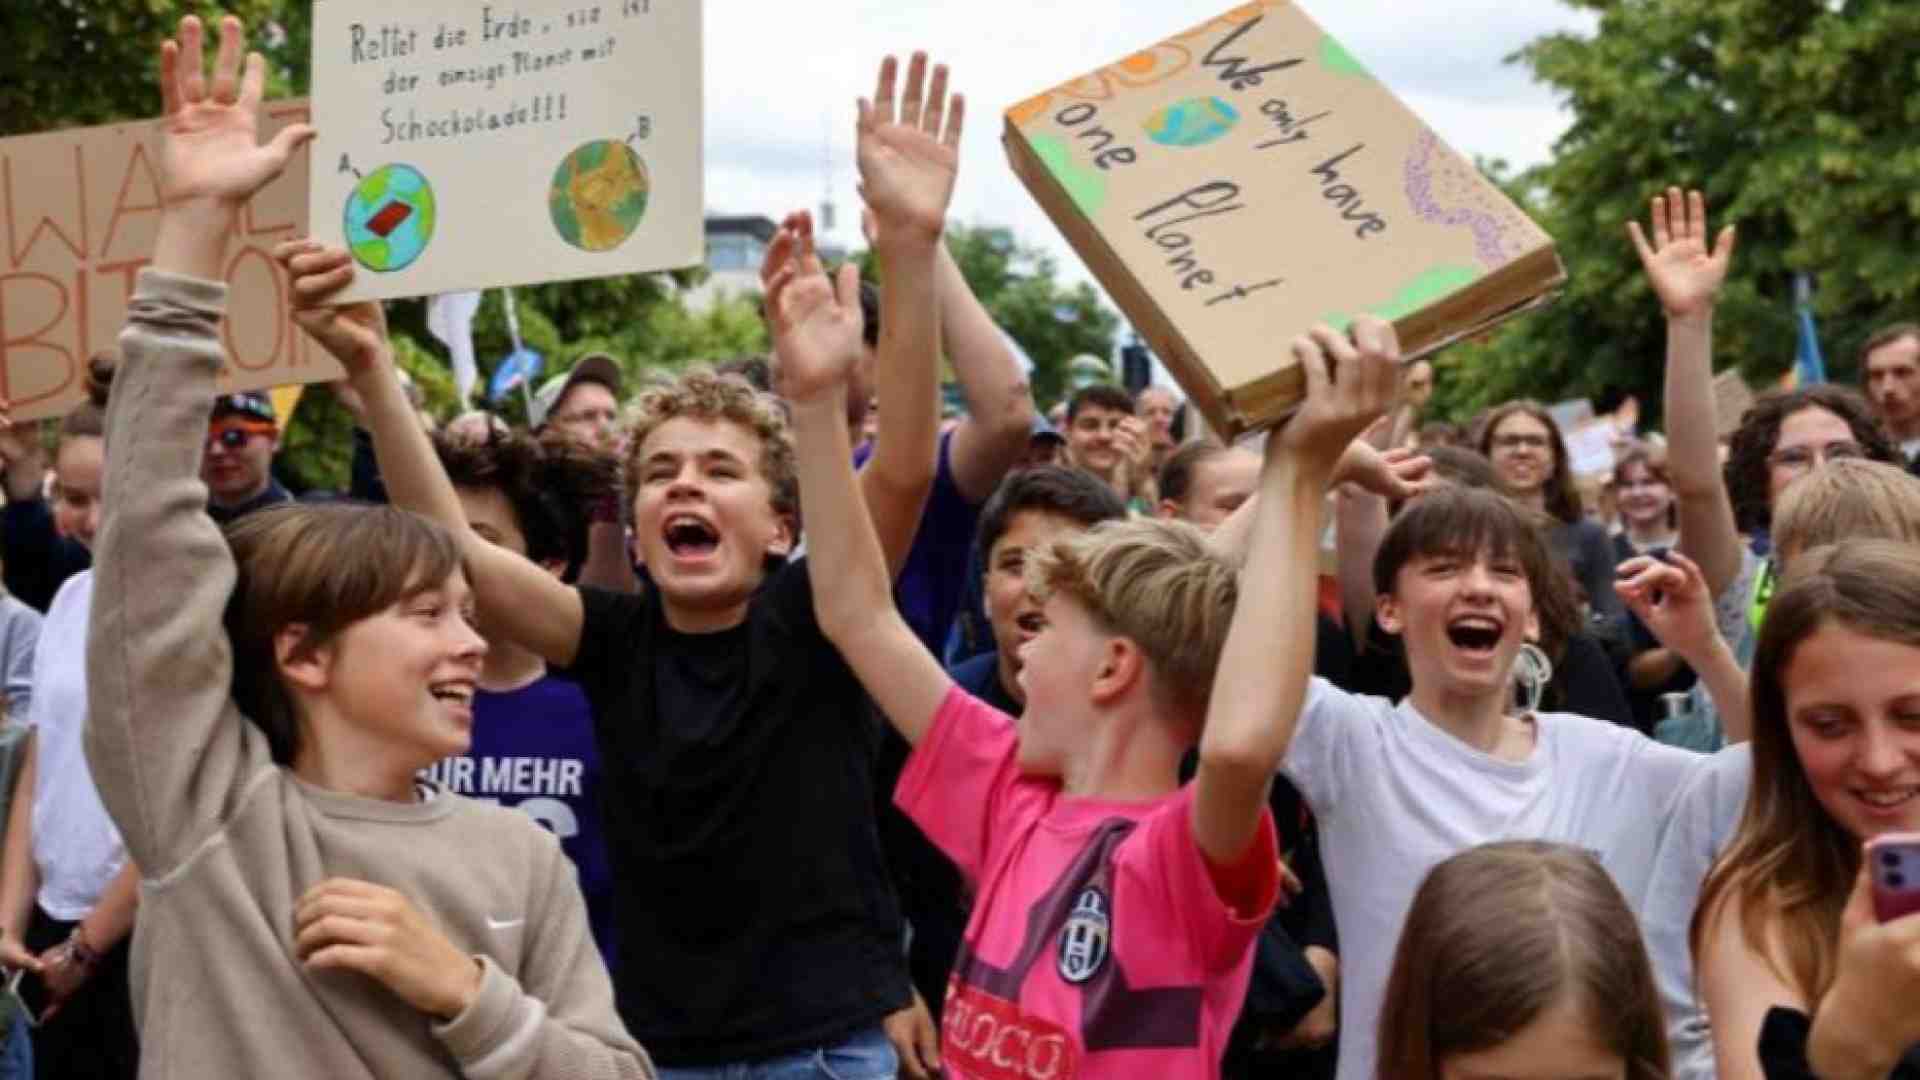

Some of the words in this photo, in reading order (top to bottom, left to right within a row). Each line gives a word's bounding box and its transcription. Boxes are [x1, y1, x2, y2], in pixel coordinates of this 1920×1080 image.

[350, 23, 417, 65] Rettet
[433, 23, 466, 49] die
[567, 7, 601, 28] sie
[383, 67, 419, 95] der
[380, 92, 566, 145] Schockolade!!!
[1201, 14, 1304, 91] We
[1253, 99, 1333, 149] only
[1309, 142, 1386, 239] have
[338, 152, 352, 174] A
[1055, 103, 1136, 171] one
[1133, 181, 1283, 307] Planet
[416, 757, 475, 794] UR
[481, 757, 584, 797] MEHR
